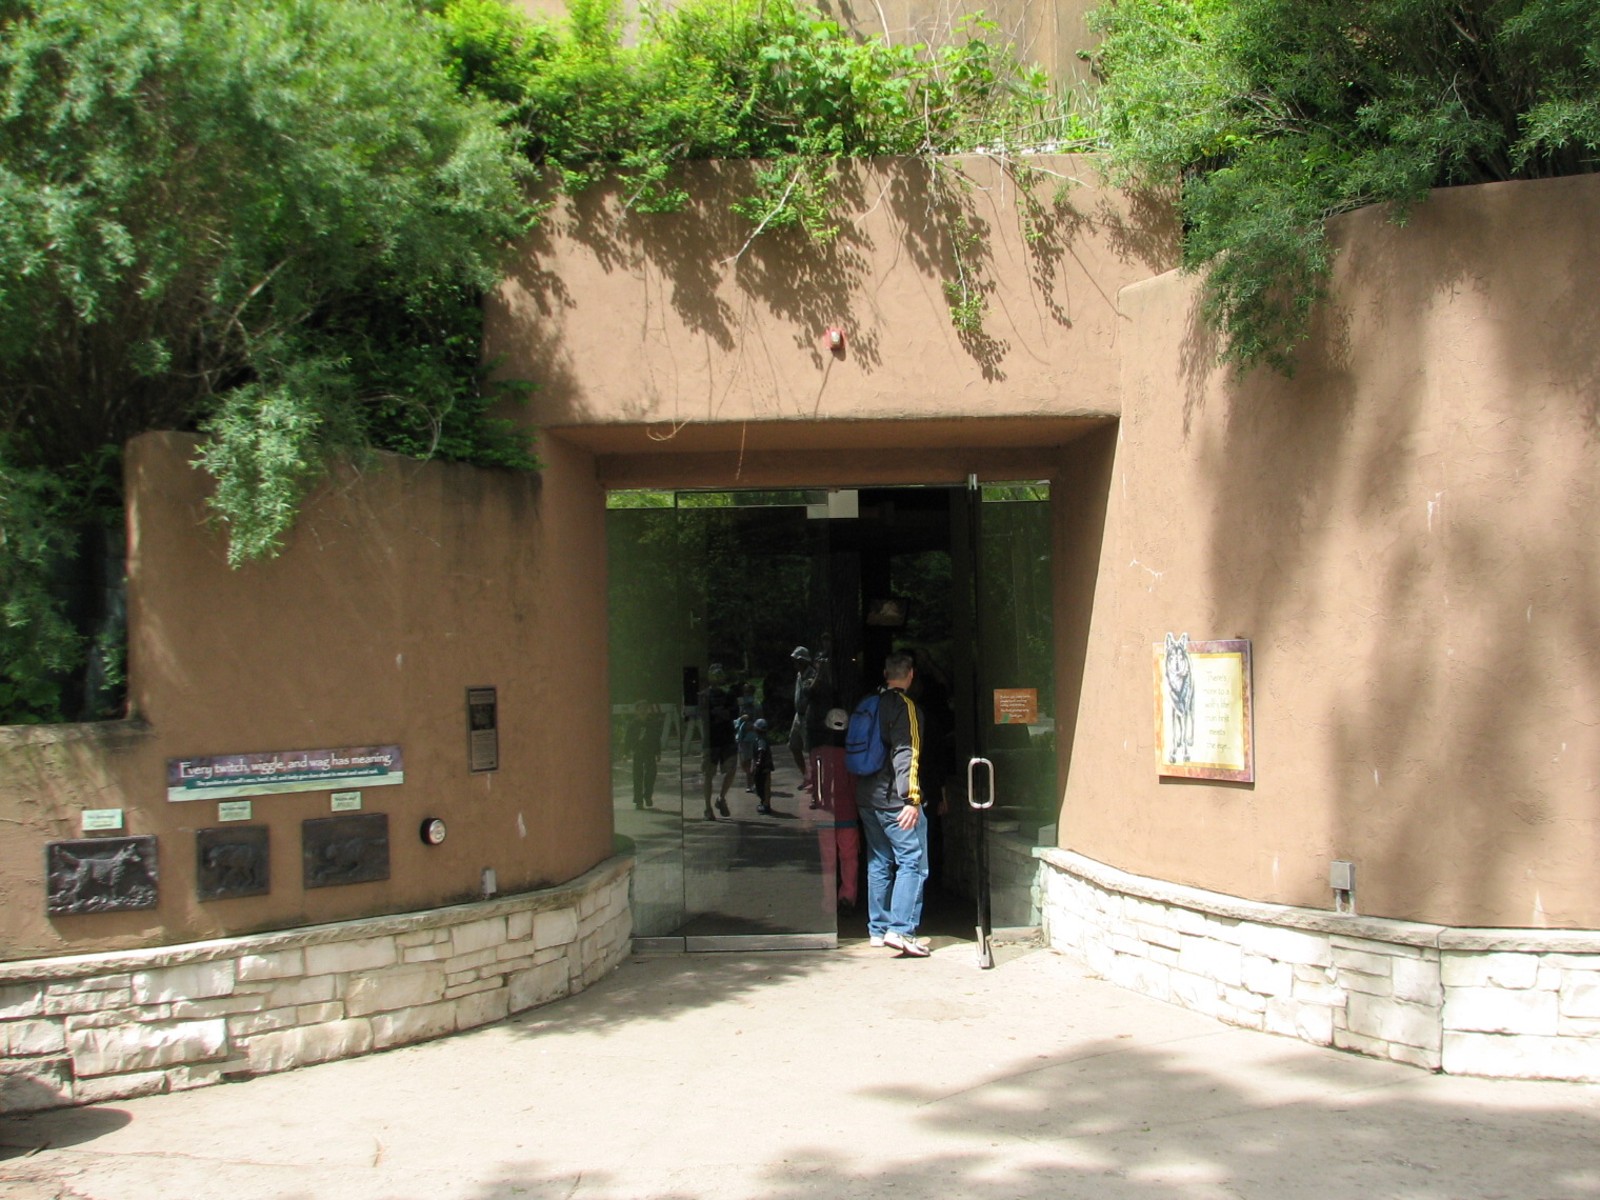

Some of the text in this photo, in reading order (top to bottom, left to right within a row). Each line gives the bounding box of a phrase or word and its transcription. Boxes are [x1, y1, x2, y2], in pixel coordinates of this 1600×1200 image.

[180, 762, 212, 779] Every
[214, 759, 250, 773] twitch,
[251, 756, 286, 774] wiggle,
[288, 754, 307, 768] and
[309, 758, 331, 770] wag
[332, 752, 349, 766] has
